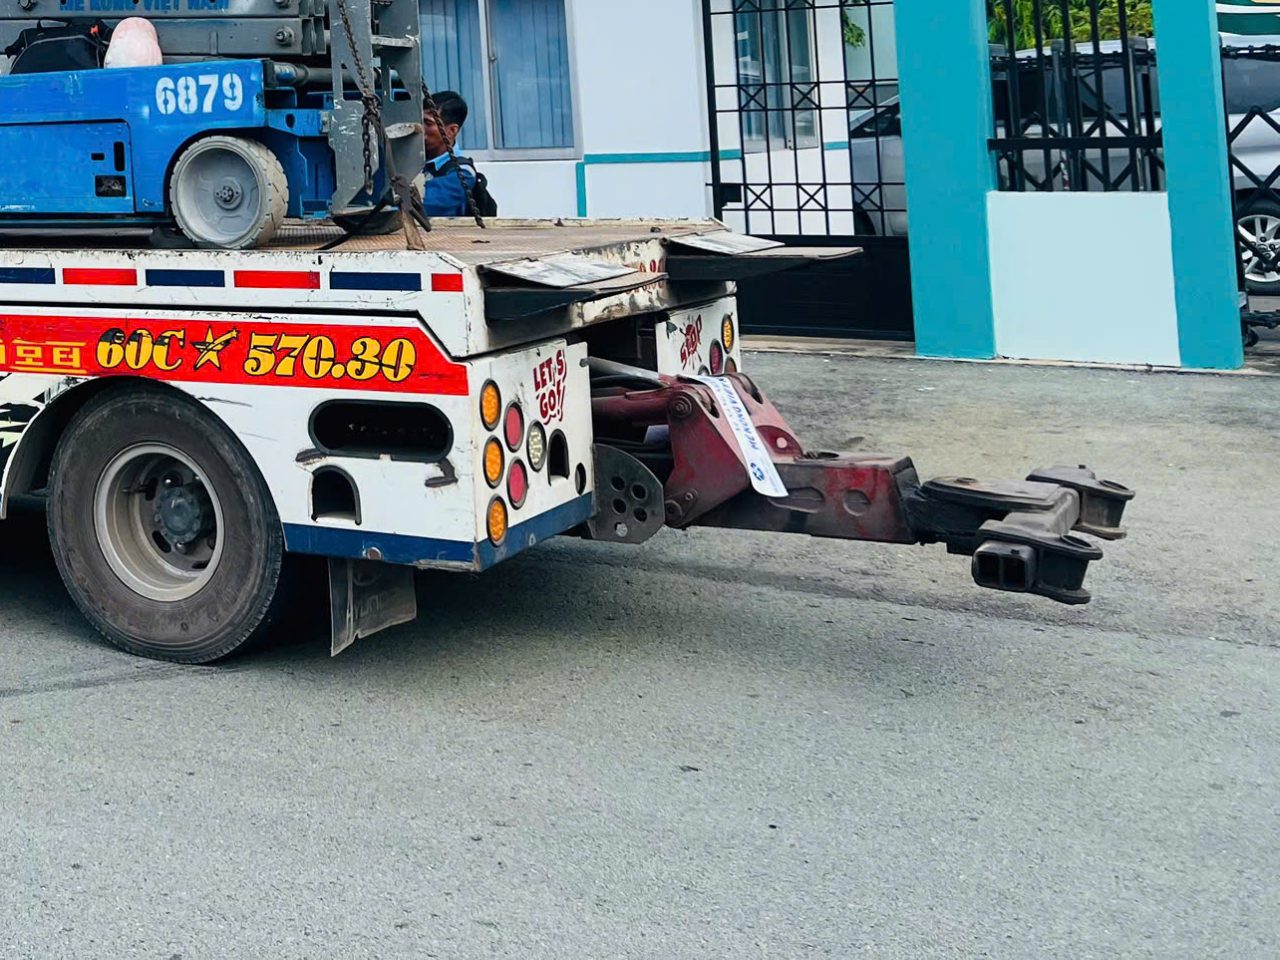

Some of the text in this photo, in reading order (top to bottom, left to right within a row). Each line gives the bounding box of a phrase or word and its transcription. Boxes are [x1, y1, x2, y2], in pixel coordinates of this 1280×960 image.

[155, 73, 243, 115] 6879
[15, 344, 81, 368] 모터
[96, 327, 187, 371] 60C
[243, 331, 417, 383] 570.30
